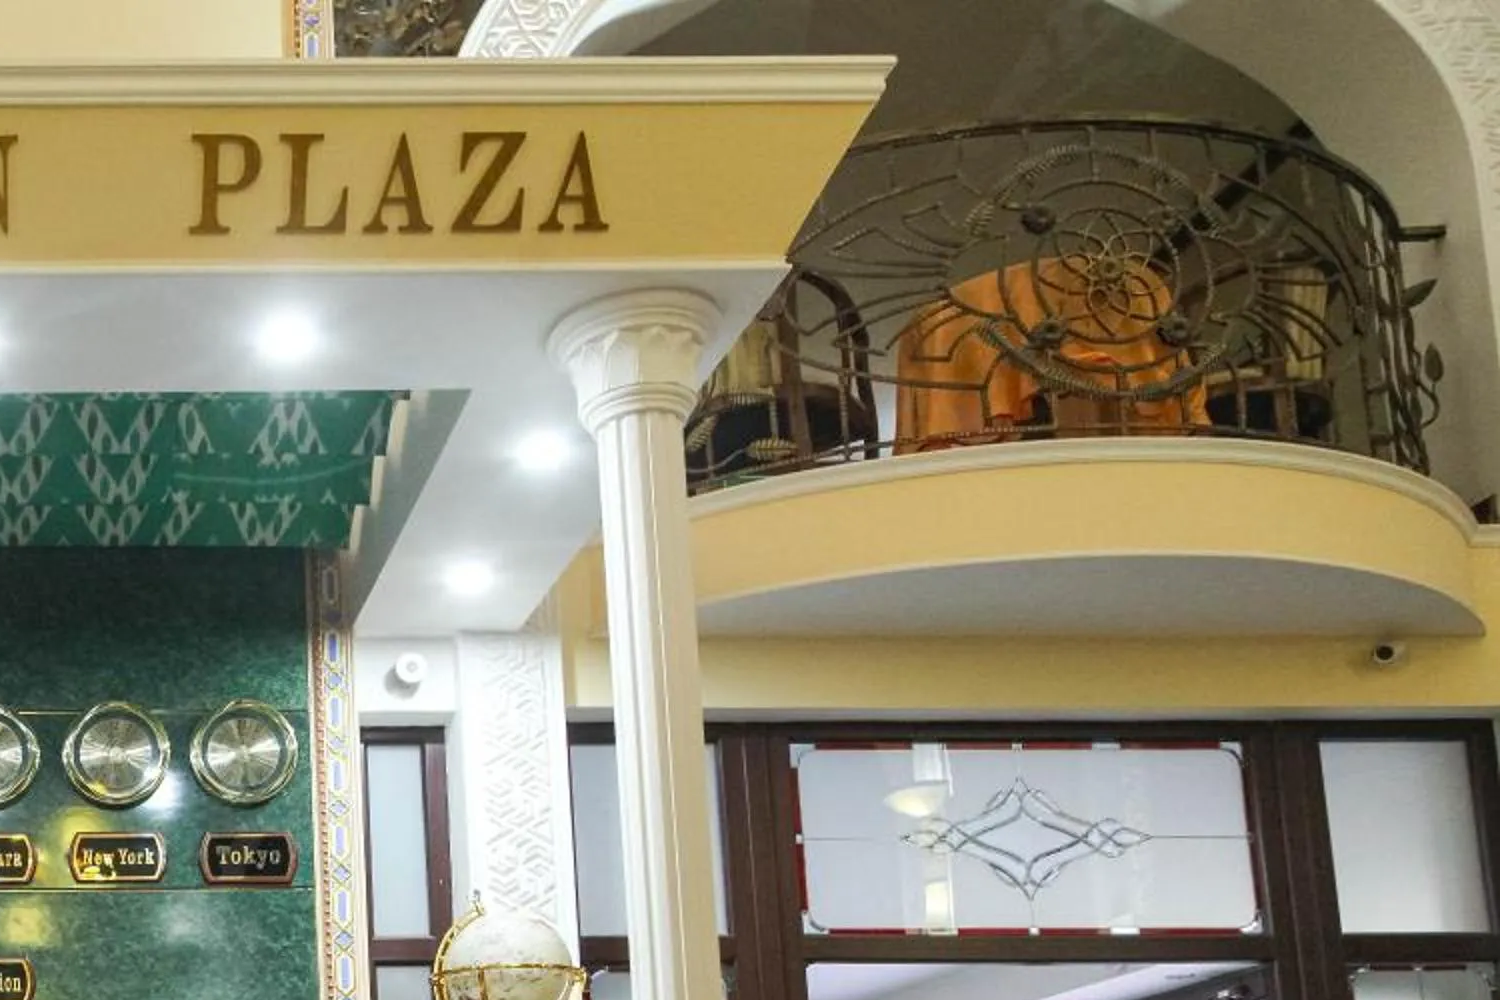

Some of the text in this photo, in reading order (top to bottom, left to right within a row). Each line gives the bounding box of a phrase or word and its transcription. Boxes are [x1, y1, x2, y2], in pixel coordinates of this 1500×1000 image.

[188, 129, 611, 236] PLAZA
[83, 847, 154, 869] New York
[216, 845, 281, 869] Tokyo
